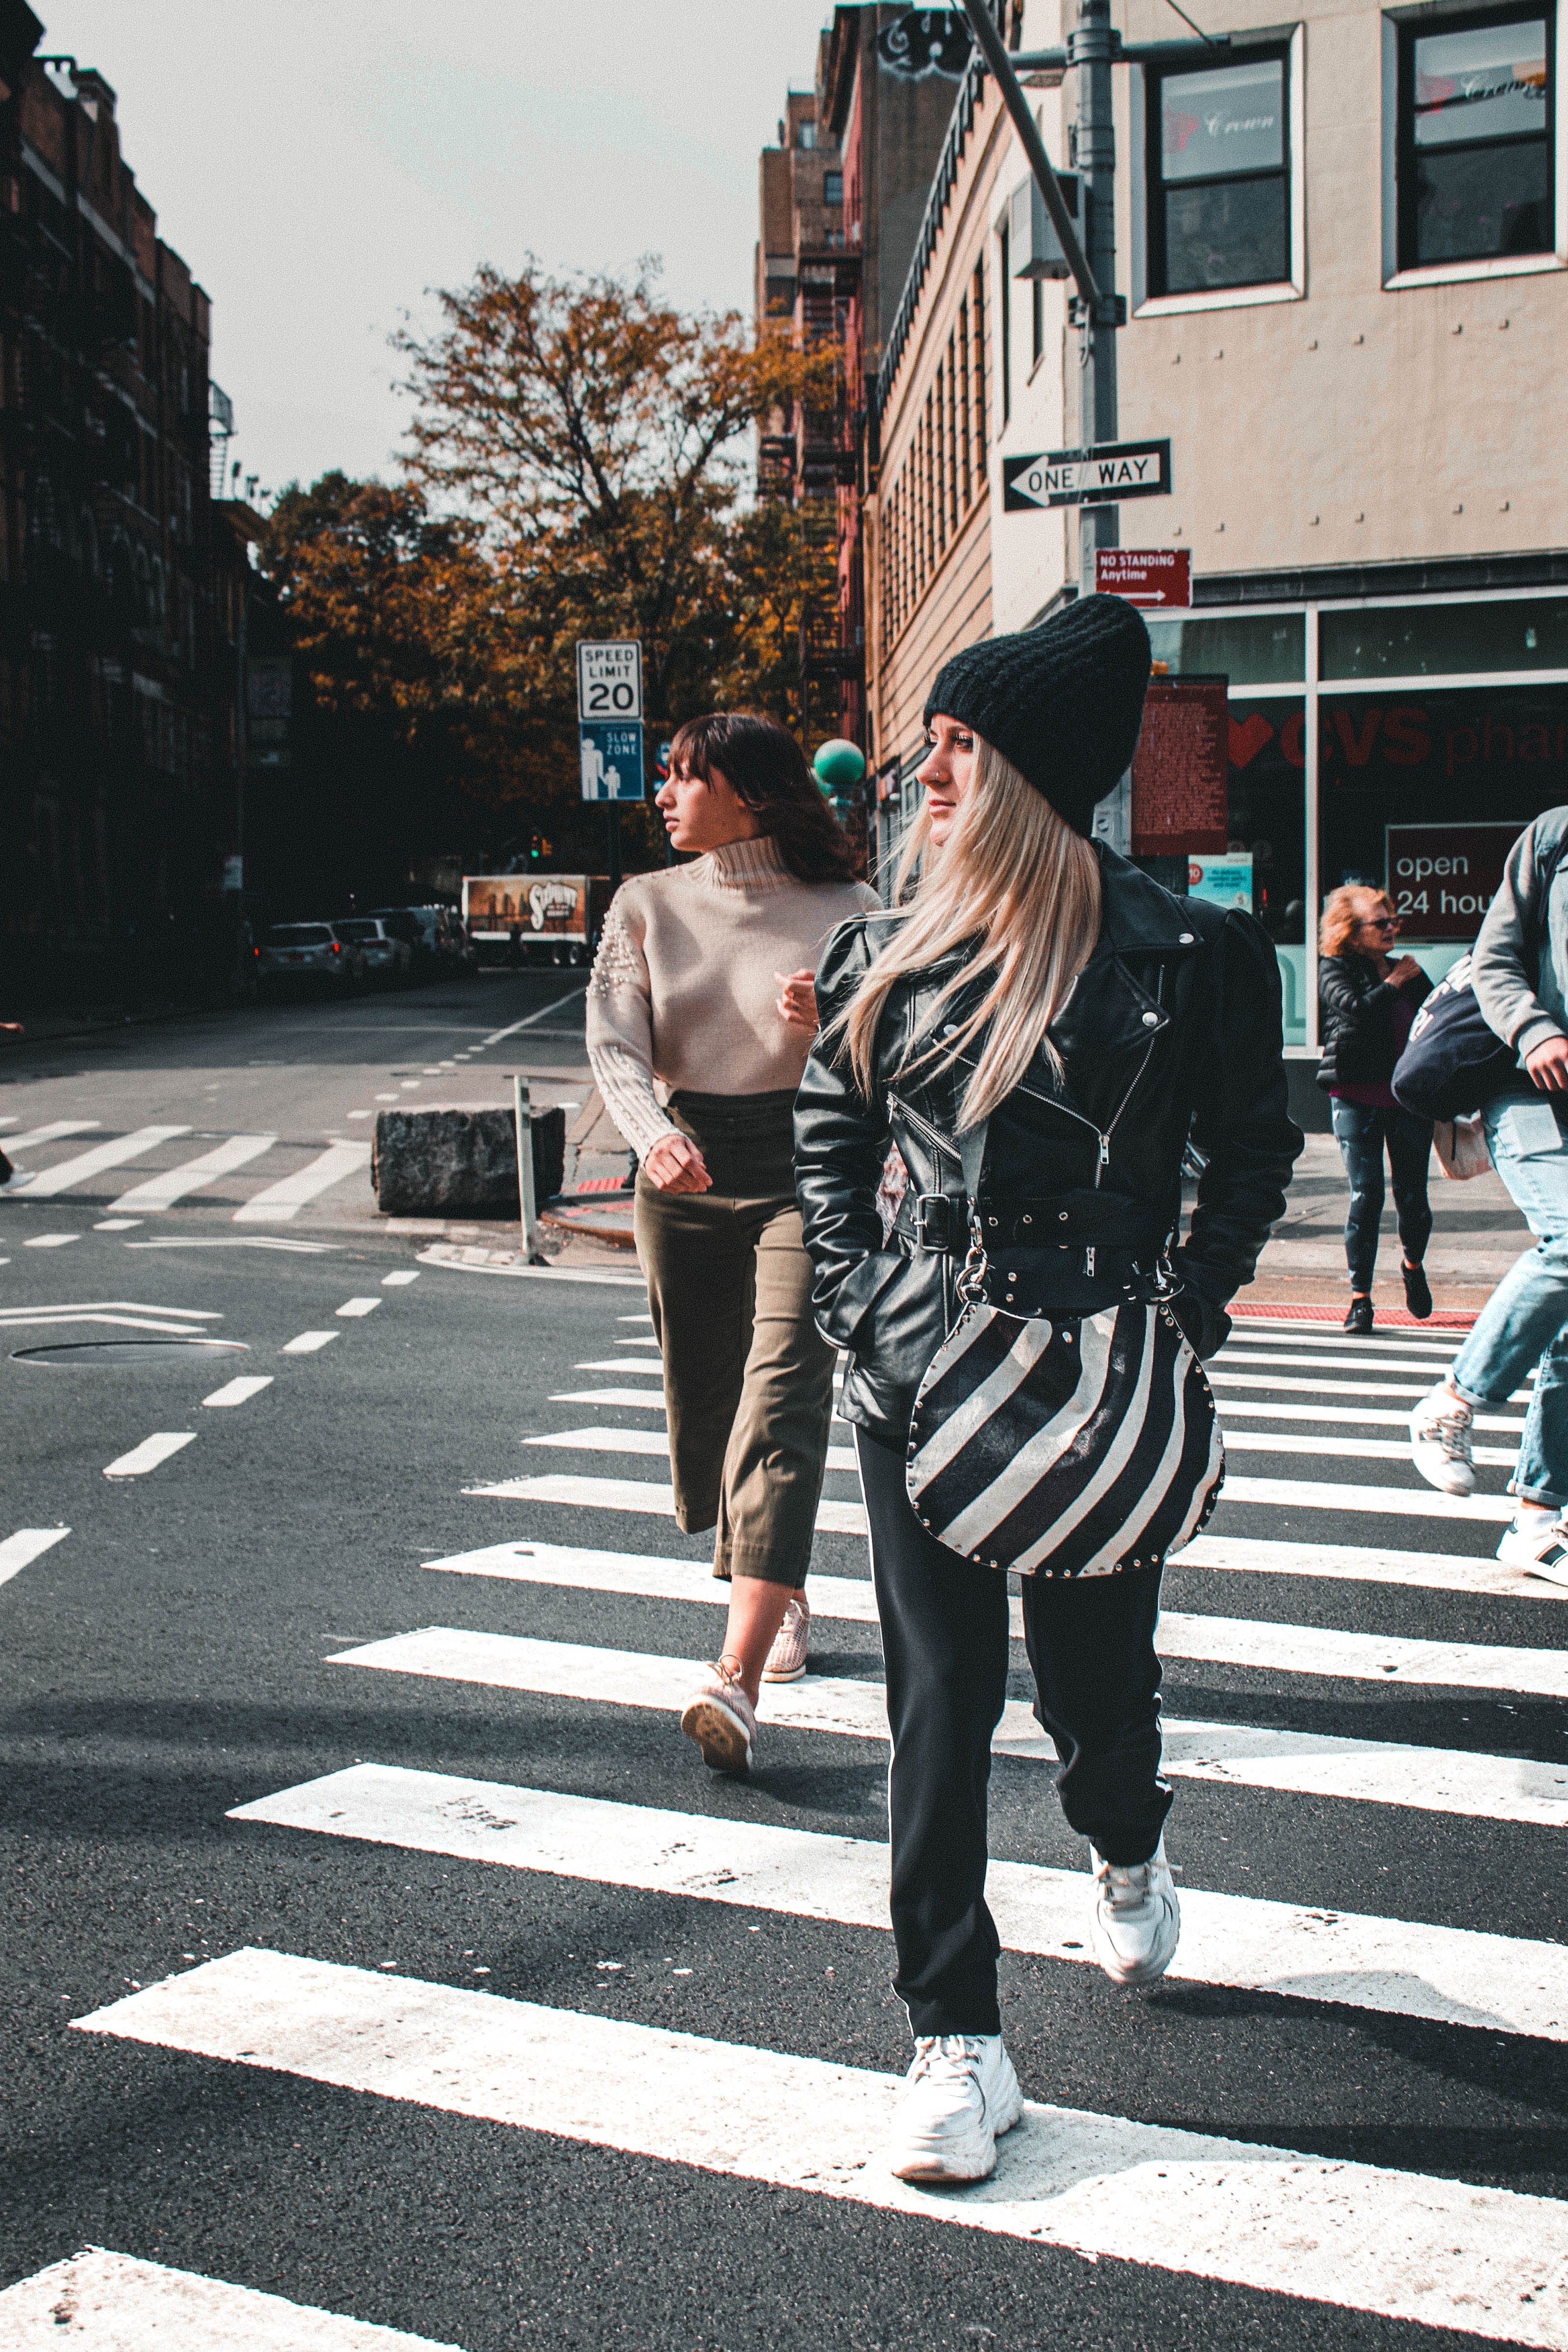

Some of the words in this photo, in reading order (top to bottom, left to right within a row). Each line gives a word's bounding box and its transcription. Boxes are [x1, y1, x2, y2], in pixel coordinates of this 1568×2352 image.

[1029, 467, 1074, 492] ONE
[1099, 458, 1148, 485] WAY
[1100, 555, 1116, 567] NO
[1119, 554, 1174, 567] STANDING
[1101, 568, 1147, 582] Anytime
[585, 649, 633, 661] SPEED
[589, 665, 630, 678] LIMIT
[589, 682, 634, 710] 20
[607, 732, 636, 742] SLOW
[1280, 707, 1431, 768] CVS
[607, 745, 637, 755] ZONE
[1396, 857, 1468, 881] open
[1397, 890, 1429, 915] 24
